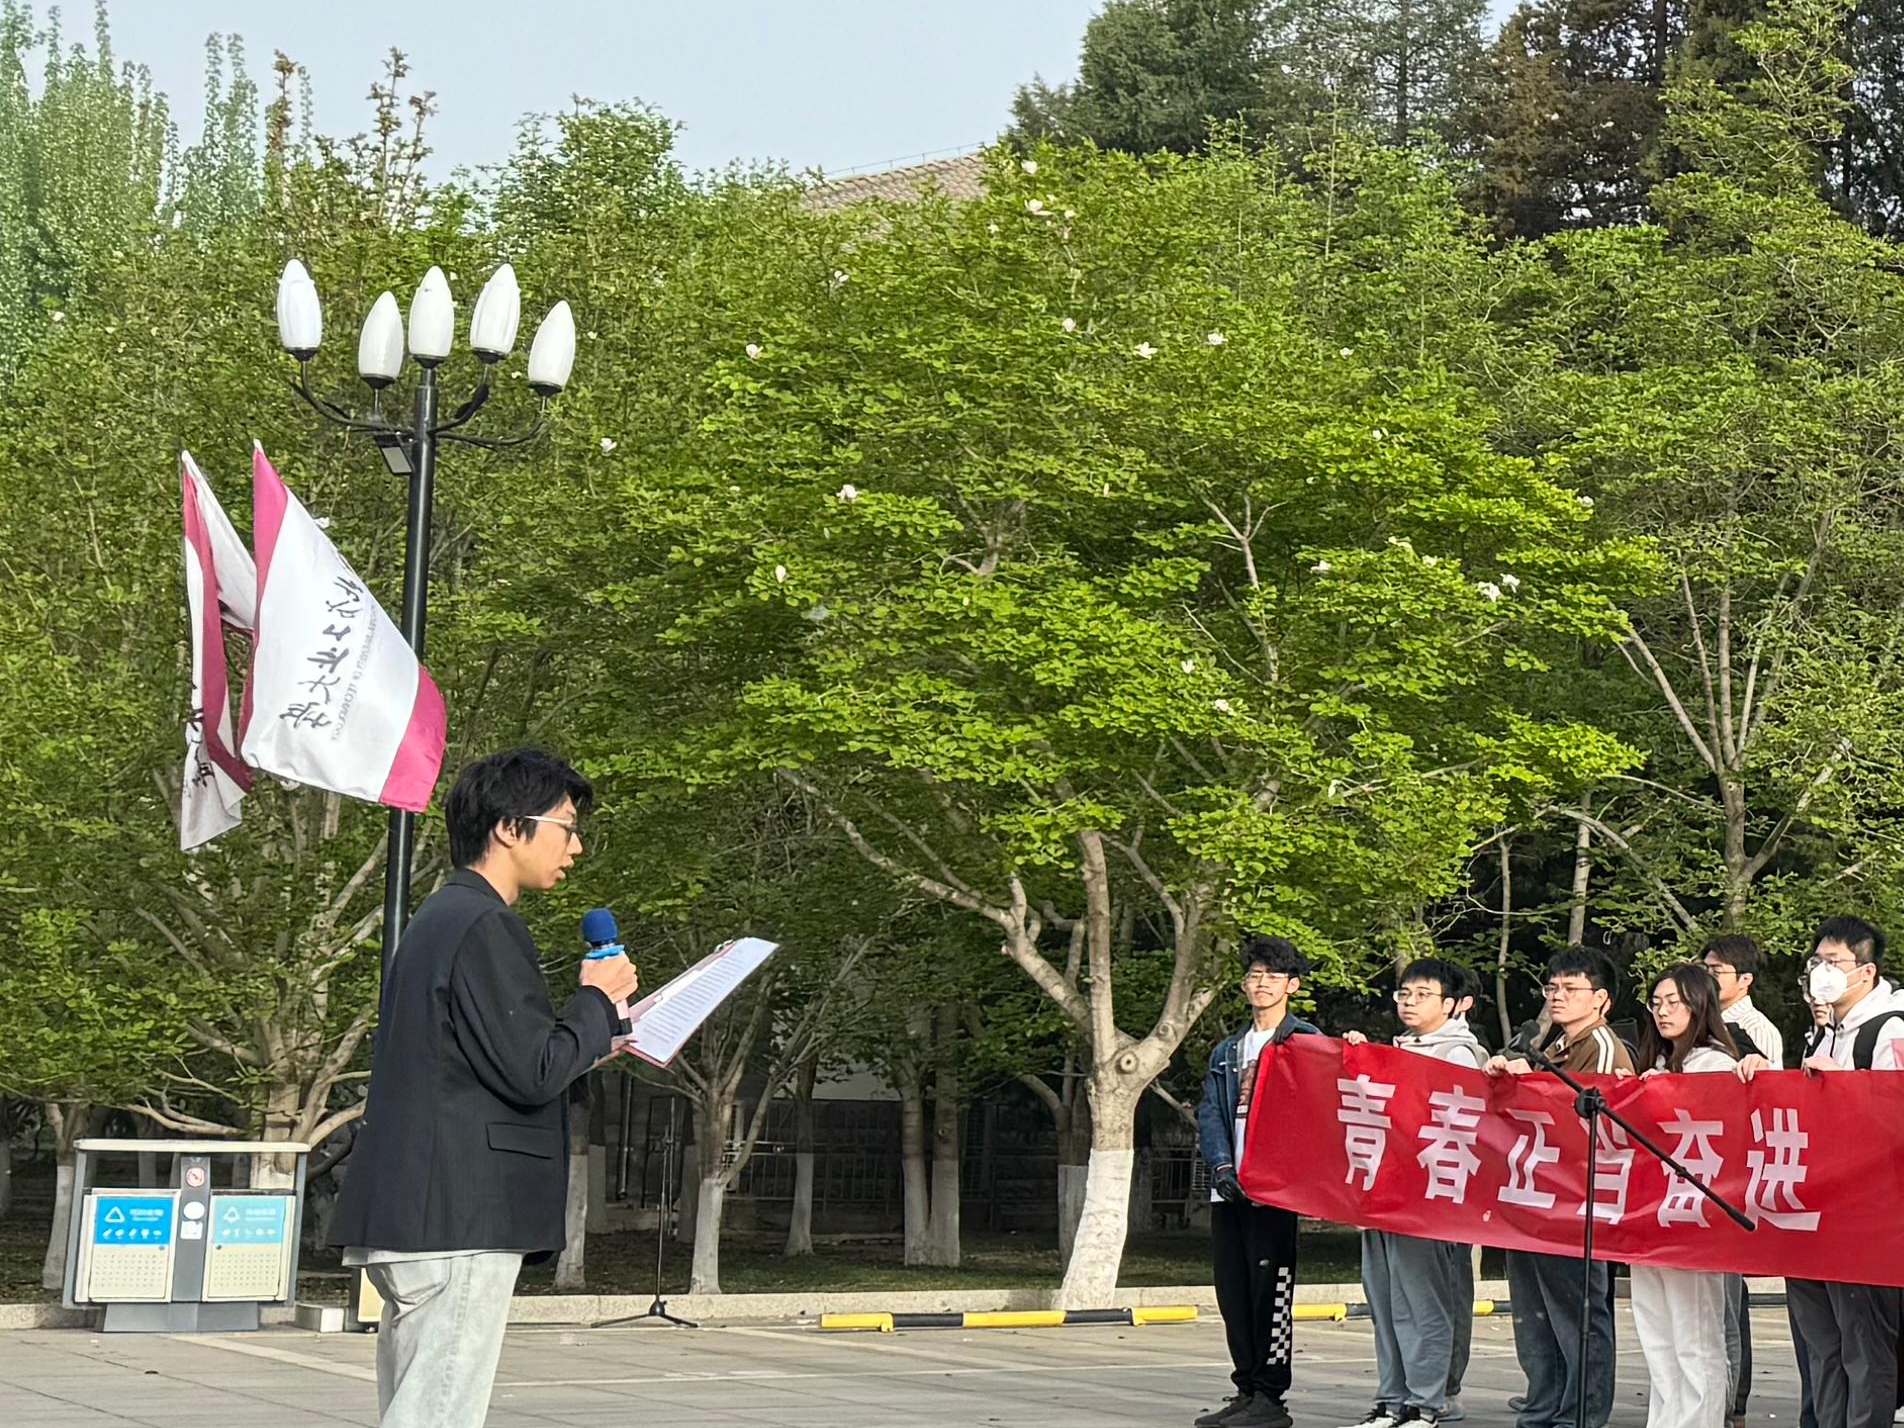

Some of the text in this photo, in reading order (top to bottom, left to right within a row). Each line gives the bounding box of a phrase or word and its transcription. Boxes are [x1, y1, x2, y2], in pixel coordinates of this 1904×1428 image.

[1337, 1074, 1821, 1231] 青春正当奋进
